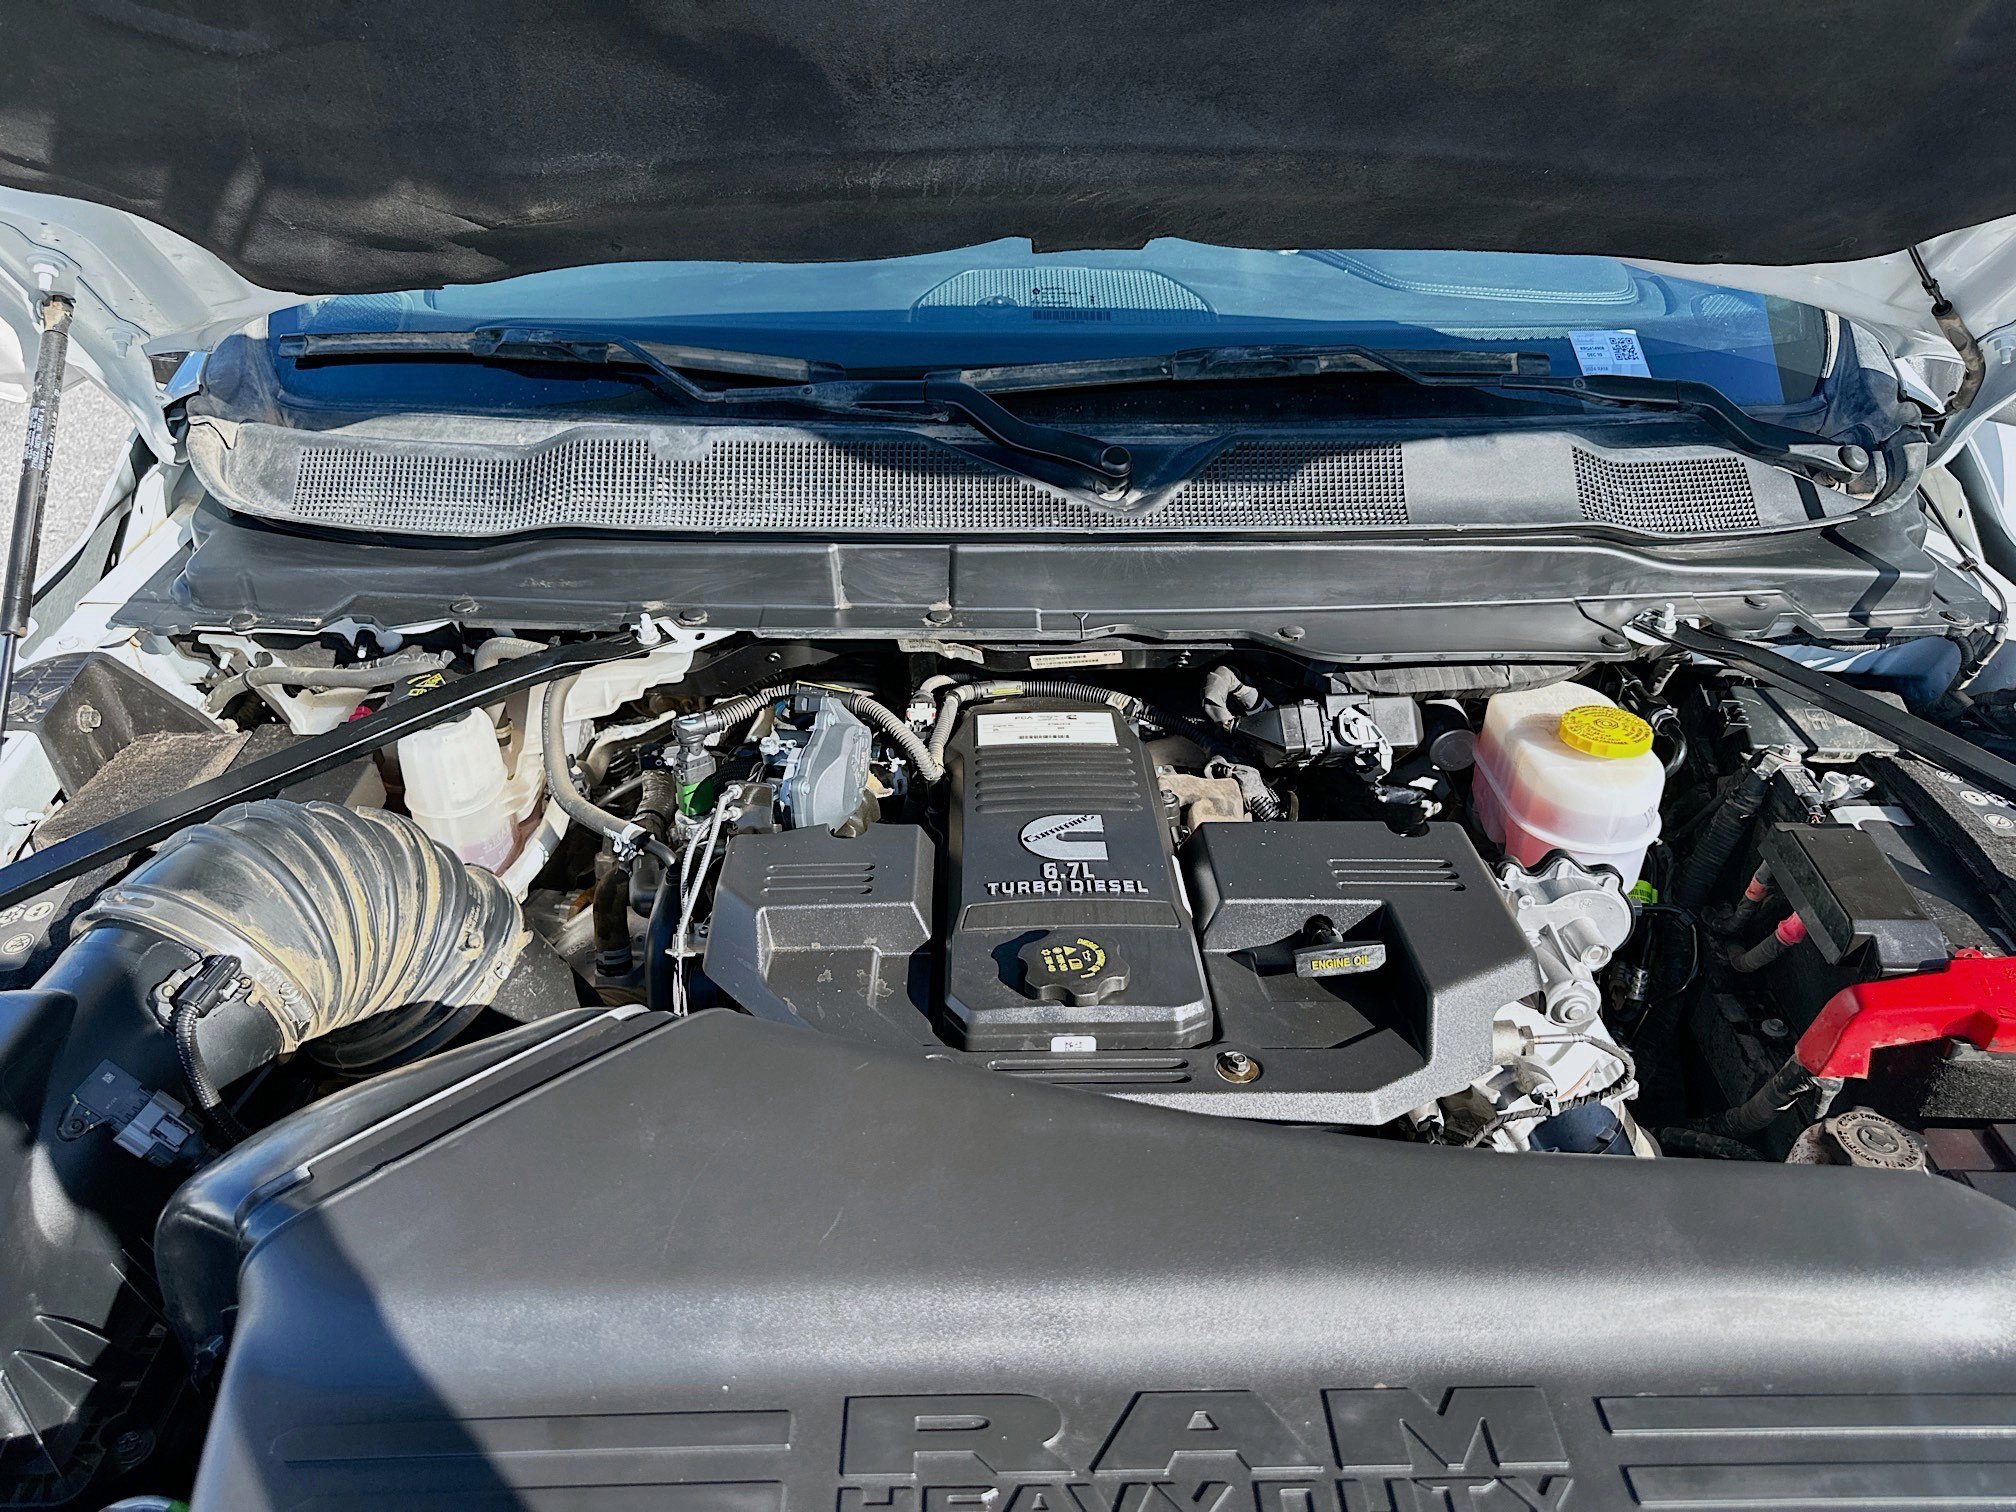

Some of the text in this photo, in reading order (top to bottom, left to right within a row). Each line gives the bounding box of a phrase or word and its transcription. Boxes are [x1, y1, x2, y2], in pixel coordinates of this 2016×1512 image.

[1042, 861, 1096, 880] 6.7L
[986, 879, 1149, 897] TURBO DIESEL
[1311, 954, 1371, 971] ENGINE OIL
[838, 1384, 1570, 1479] RAM
